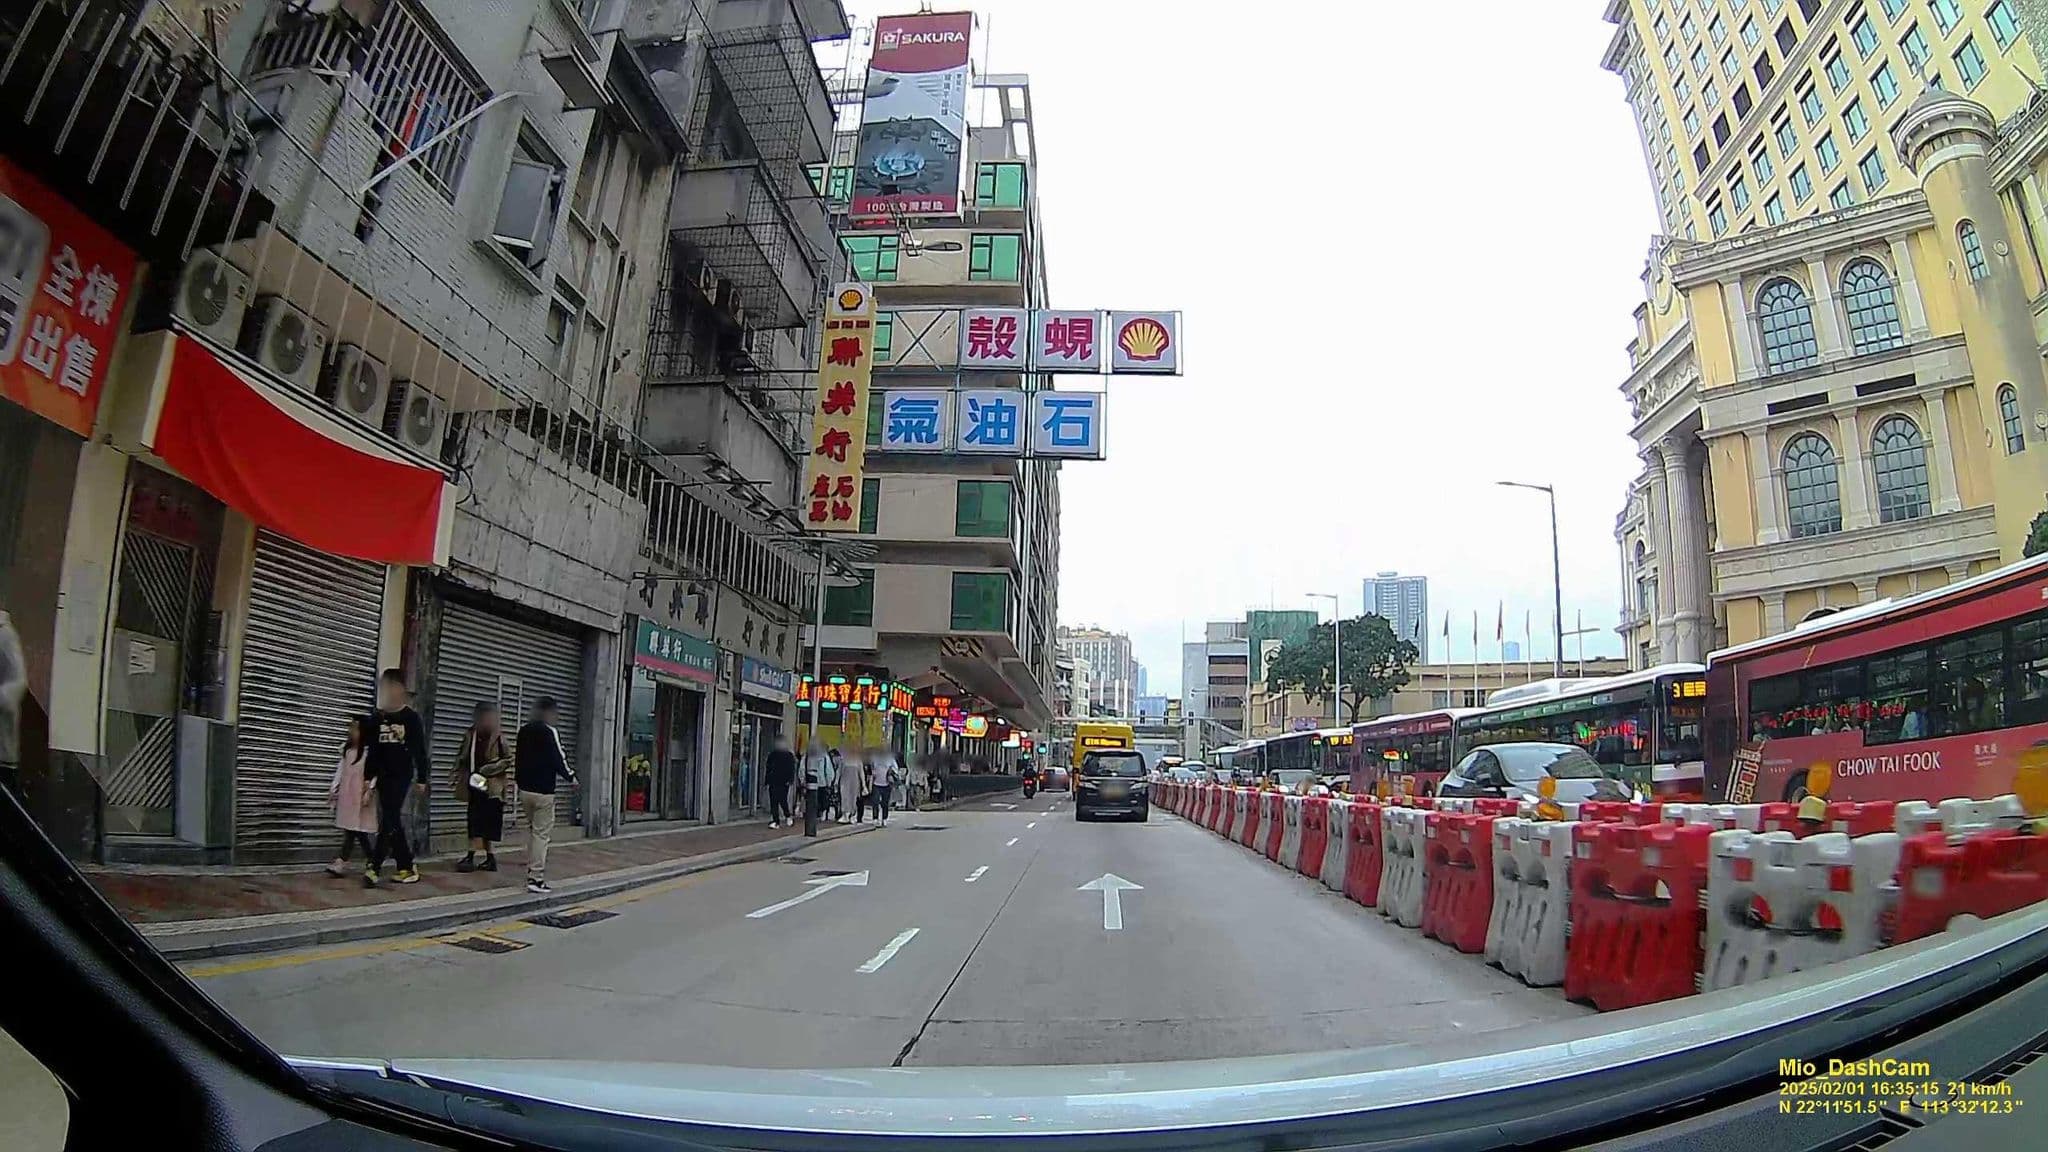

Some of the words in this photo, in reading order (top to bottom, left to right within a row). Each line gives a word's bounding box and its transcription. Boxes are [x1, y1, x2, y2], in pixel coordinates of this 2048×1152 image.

[902, 31, 965, 45] SAKURA
[22, 314, 99, 398] 出售
[797, 681, 881, 705] 珠寶金行
[1673, 682, 1680, 698] 3
[1837, 757, 1879, 778] CHOW
[1881, 755, 1899, 773] TAI
[1903, 751, 1942, 771] FOOK
